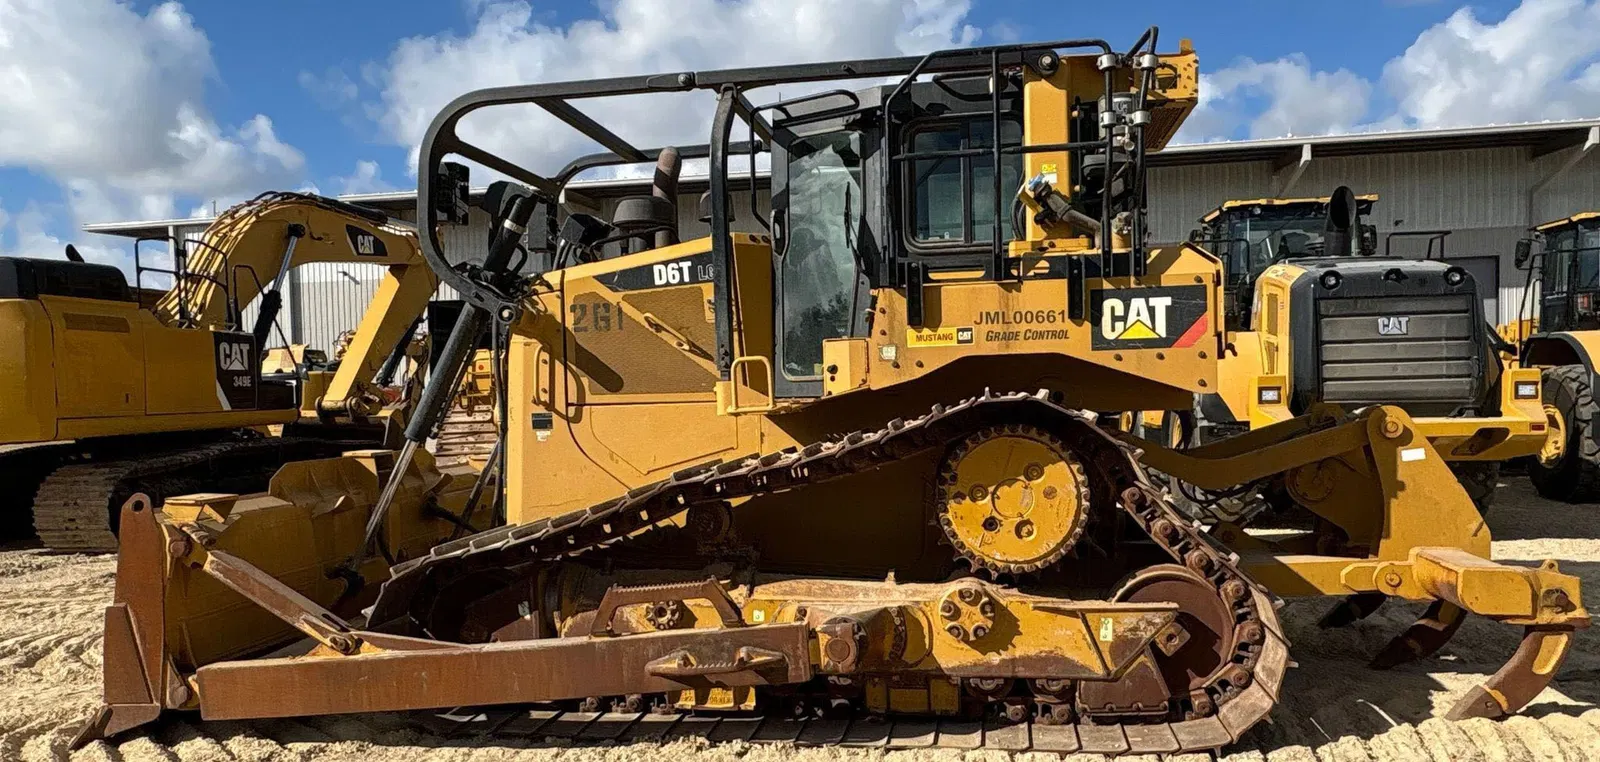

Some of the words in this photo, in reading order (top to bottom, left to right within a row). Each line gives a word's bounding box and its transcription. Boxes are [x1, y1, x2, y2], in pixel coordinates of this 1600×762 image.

[357, 235, 376, 254] CAT
[653, 261, 692, 286] D6T
[973, 310, 1066, 326] JML00661
[1101, 296, 1172, 340] CAT
[1377, 316, 1409, 335] CAT
[915, 332, 953, 342] MUSTANG
[958, 331, 972, 340] CAT
[985, 329, 1021, 342] GRADE
[1023, 328, 1070, 341] CONTROL
[219, 341, 250, 371] CAT
[233, 375, 251, 387] 349E
